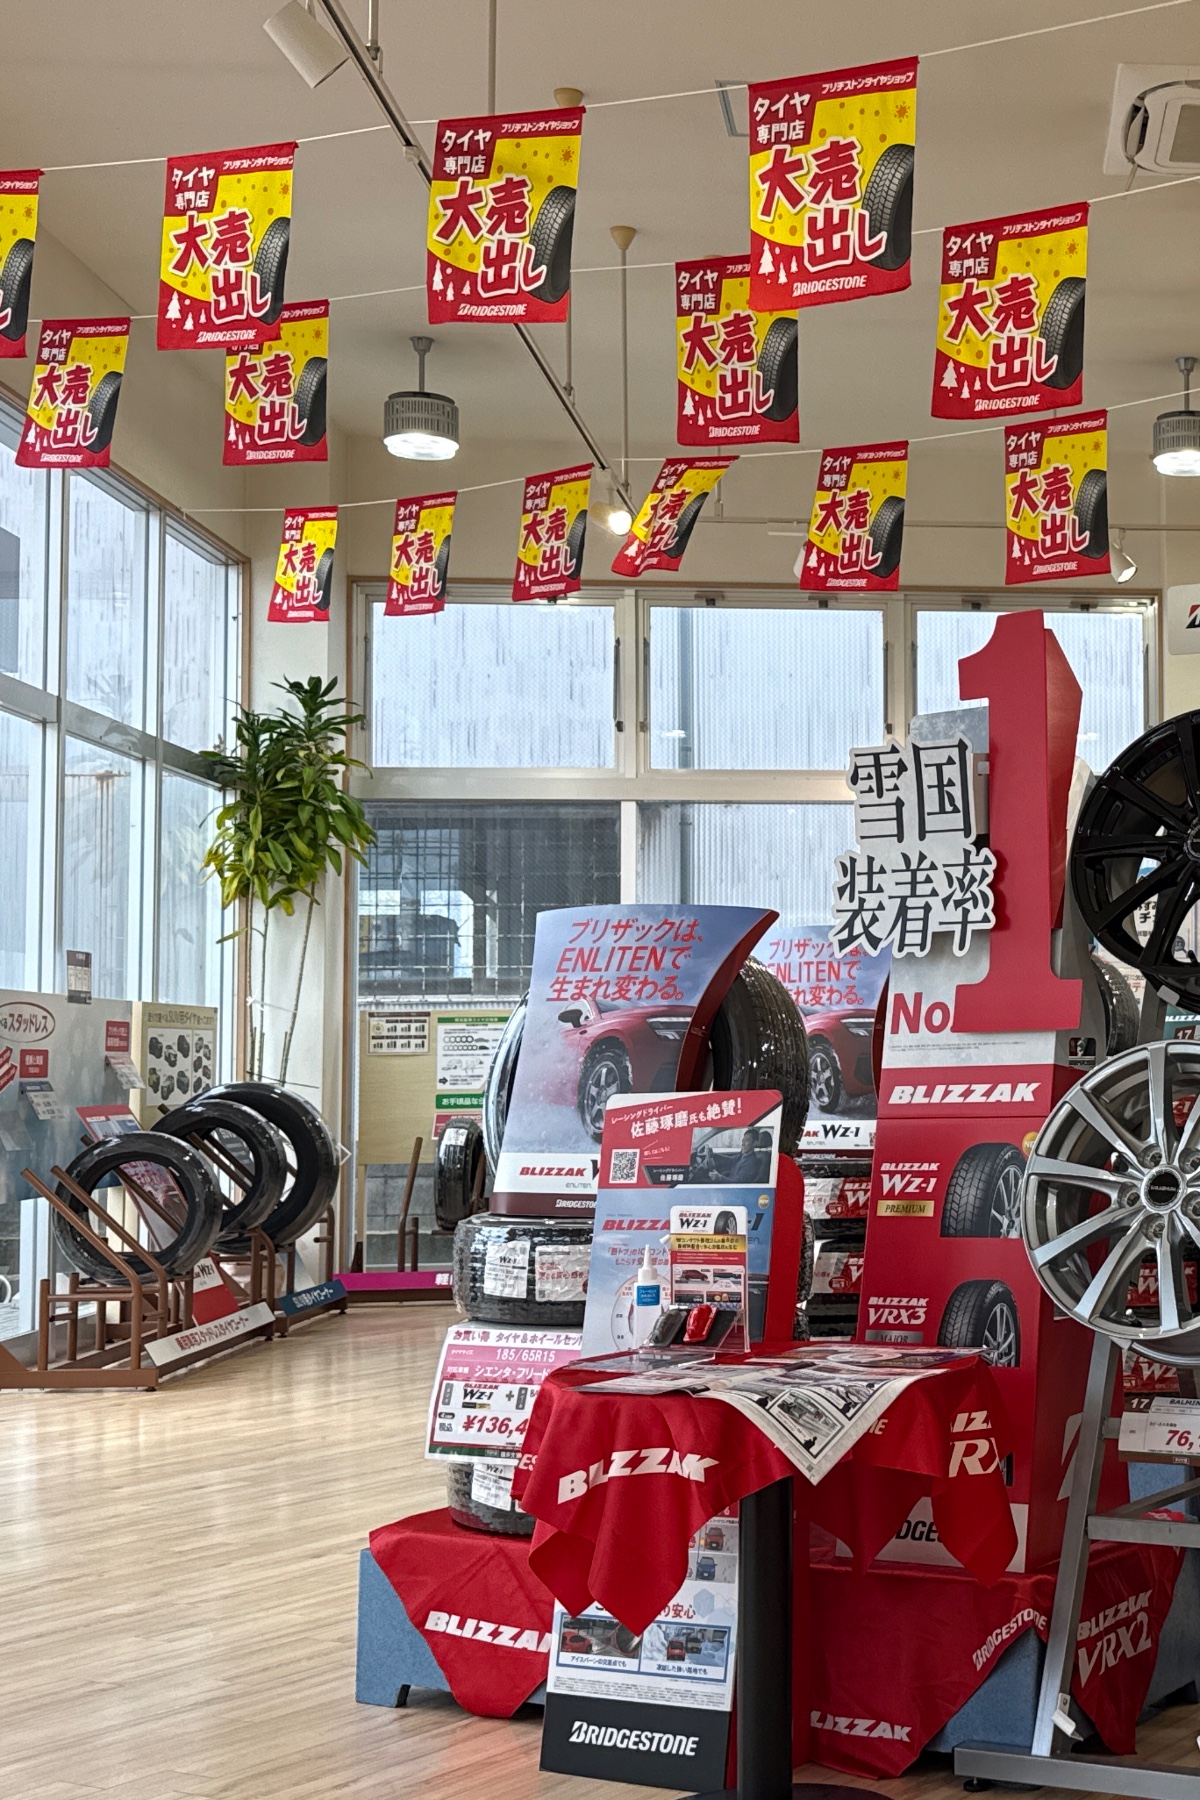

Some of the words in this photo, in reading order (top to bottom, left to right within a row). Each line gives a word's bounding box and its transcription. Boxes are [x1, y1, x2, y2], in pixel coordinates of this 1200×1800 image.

[172, 167, 216, 189] タイヤ
[175, 192, 210, 209] 専門店
[947, 232, 994, 256] タイヤ
[948, 258, 990, 277] 専門店
[678, 269, 718, 290] タイヤ
[792, 275, 867, 297] BRIDGESTONE
[458, 303, 527, 316] BRIDGESTONE
[680, 294, 716, 310] 専門店
[42, 330, 72, 345] タイヤ
[196, 328, 257, 343] BRIDGESTONE
[682, 310, 757, 370] 大売
[41, 347, 67, 361] 専門店
[33, 364, 92, 407] 大売
[228, 352, 295, 403] 大売
[716, 368, 774, 420] 出し
[974, 394, 1040, 411] BRIDGESTONE
[50, 409, 98, 449] 出し
[255, 402, 307, 446] 出し
[709, 425, 761, 437] BRIDGESTONE
[1007, 432, 1041, 449] タイヤ
[246, 450, 295, 460] BRIDGESTONE
[1009, 451, 1038, 467] 専門店
[1010, 465, 1075, 522] 大売
[814, 487, 873, 533] 大売
[520, 508, 567, 551] 大売
[1039, 514, 1090, 559] 出し
[282, 541, 317, 576] 大売
[395, 530, 435, 567] 大売
[838, 536, 884, 573] 出し
[537, 546, 576, 581] 出し
[1033, 561, 1078, 575] BRIDGESTONE
[292, 575, 322, 607] 出し
[408, 565, 442, 598] 出し
[850, 742, 970, 844] 雪国
[834, 850, 994, 954] 装着率
[568, 917, 703, 945] ブリザックは、
[556, 946, 692, 973] ENLITENで
[549, 975, 685, 1002] 生まれ変わる。
[888, 1083, 1041, 1104] BLIZZAK
[612, 1105, 673, 1124] レーシングドライバー
[822, 1125, 860, 1139] WZ-1
[519, 1166, 587, 1177] BLIZZAK
[880, 1163, 941, 1171] BLIZZAK
[880, 1174, 937, 1196] WZ-1
[885, 1204, 926, 1213] PREMIUM
[602, 1219, 670, 1230] BLIZZA
[679, 1218, 707, 1229] WZ-1
[867, 1297, 929, 1306] BLIZZAK
[867, 1307, 927, 1326] VRX3
[453, 1330, 490, 1341] お買い得
[496, 1348, 555, 1362] 185/65R15
[463, 1389, 494, 1400] WZ-1
[1131, 1398, 1150, 1408] 17
[462, 1415, 529, 1438] ¥136,4
[1076, 1590, 1153, 1641] BLIZZAK
[1076, 1612, 1152, 1687] VRX2
[810, 1711, 911, 1742] LIZZAK
[569, 1721, 699, 1756] BRIDGESTONE
